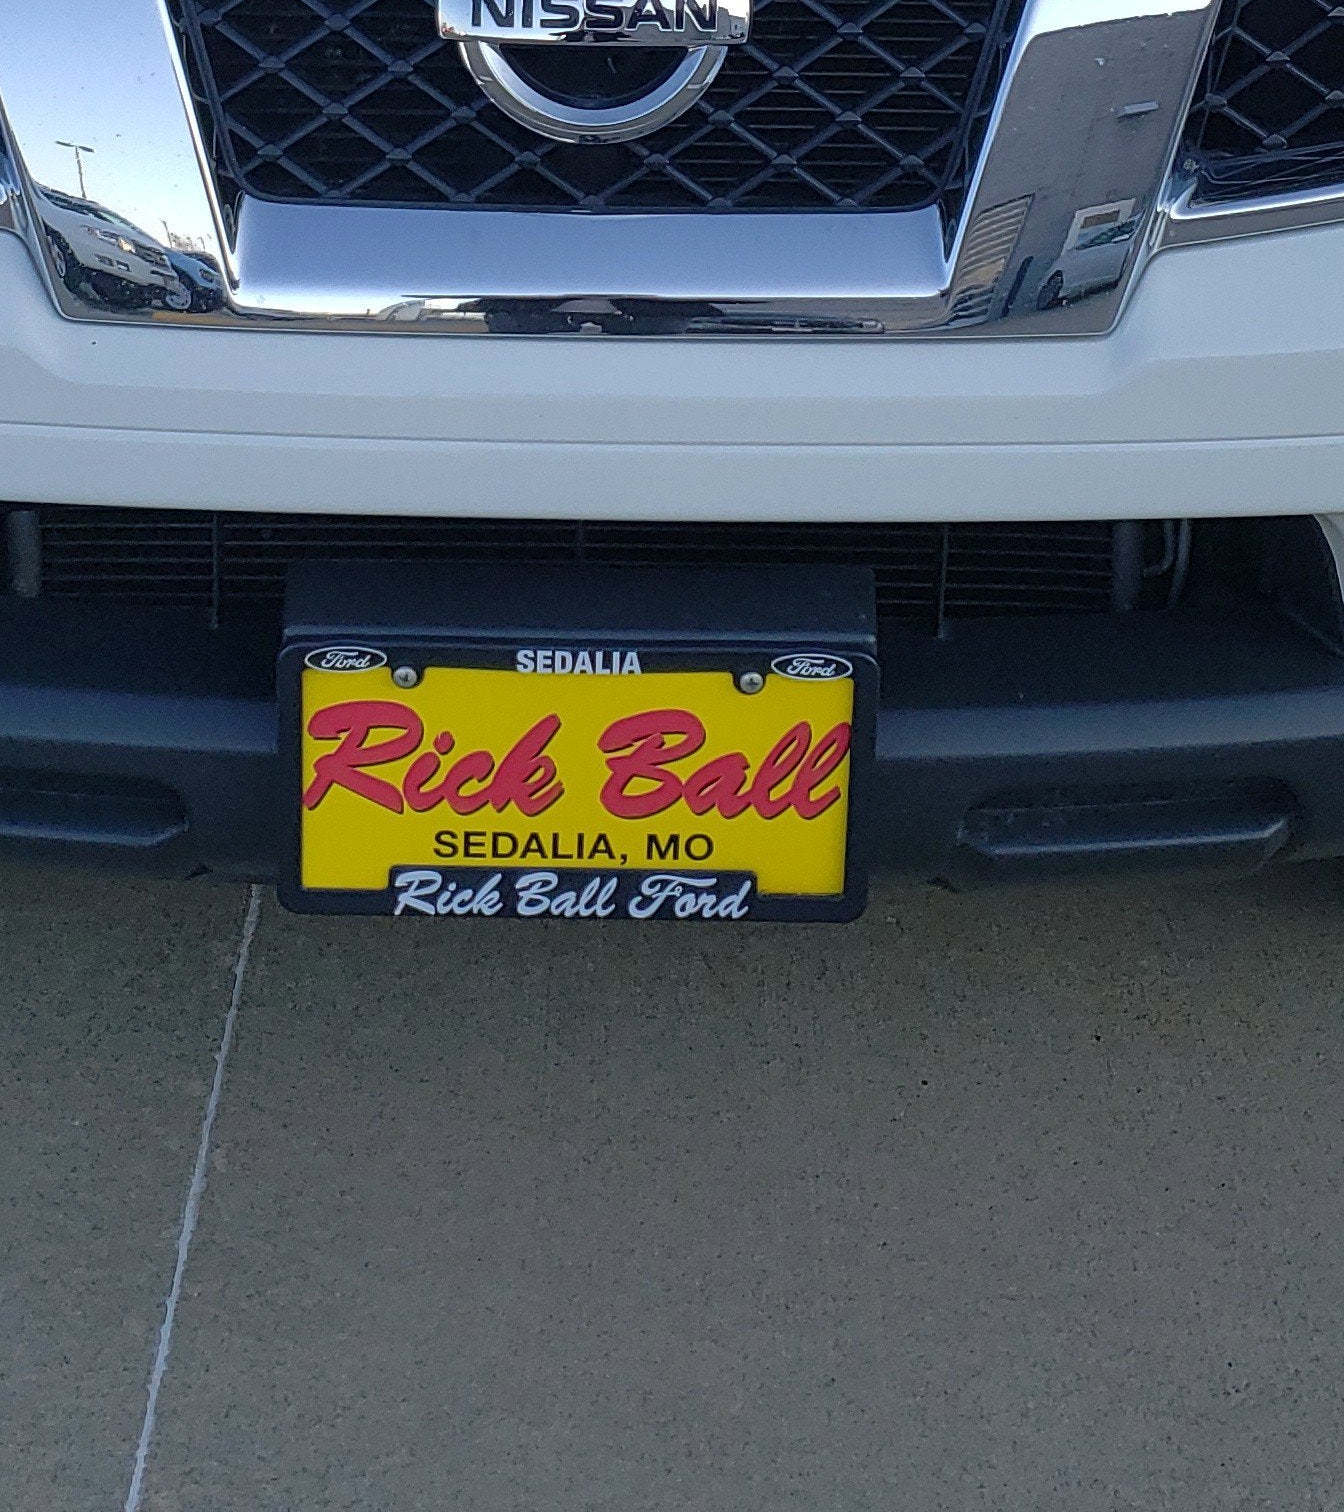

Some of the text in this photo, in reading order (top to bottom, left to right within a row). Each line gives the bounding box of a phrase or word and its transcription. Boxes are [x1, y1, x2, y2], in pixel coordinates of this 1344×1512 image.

[320, 651, 371, 668] Ford
[516, 650, 642, 676] SEDALIA
[786, 658, 836, 676] Ford
[302, 700, 852, 821] Rick Ball
[433, 831, 715, 864] SEDALIA, MO
[393, 871, 749, 920] Rick Ball Ford
